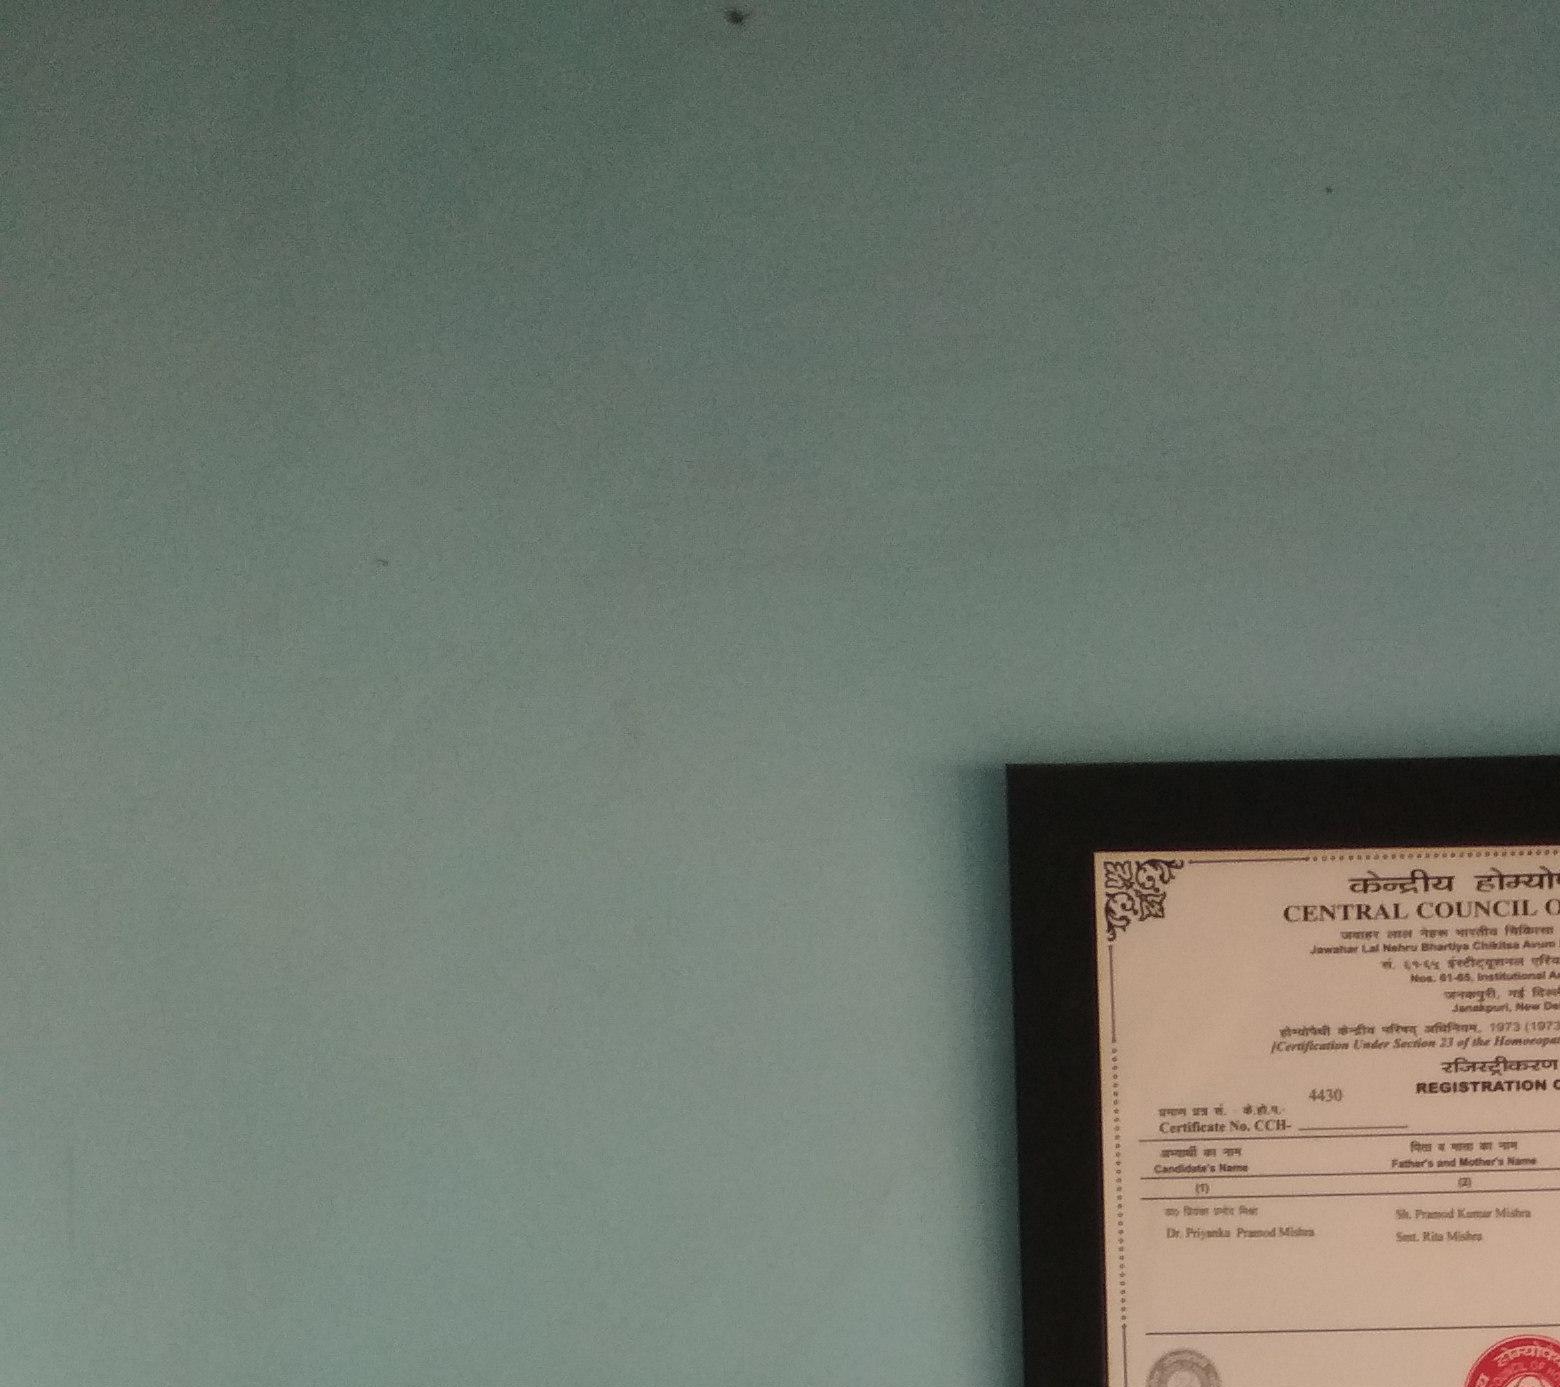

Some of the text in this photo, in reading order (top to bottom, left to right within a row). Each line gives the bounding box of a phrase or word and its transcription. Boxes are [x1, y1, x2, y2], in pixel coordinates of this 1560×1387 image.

[1348, 868, 1455, 895] केन्द्रीय
[1283, 903, 1408, 922] CENTRAL
[1416, 899, 1537, 919] COUNCIL
[1309, 1088, 1344, 1102] 4430
[1415, 1079, 1548, 1095] REGISTRATION
[1159, 1117, 1291, 1135] Certificate No. CCH-
